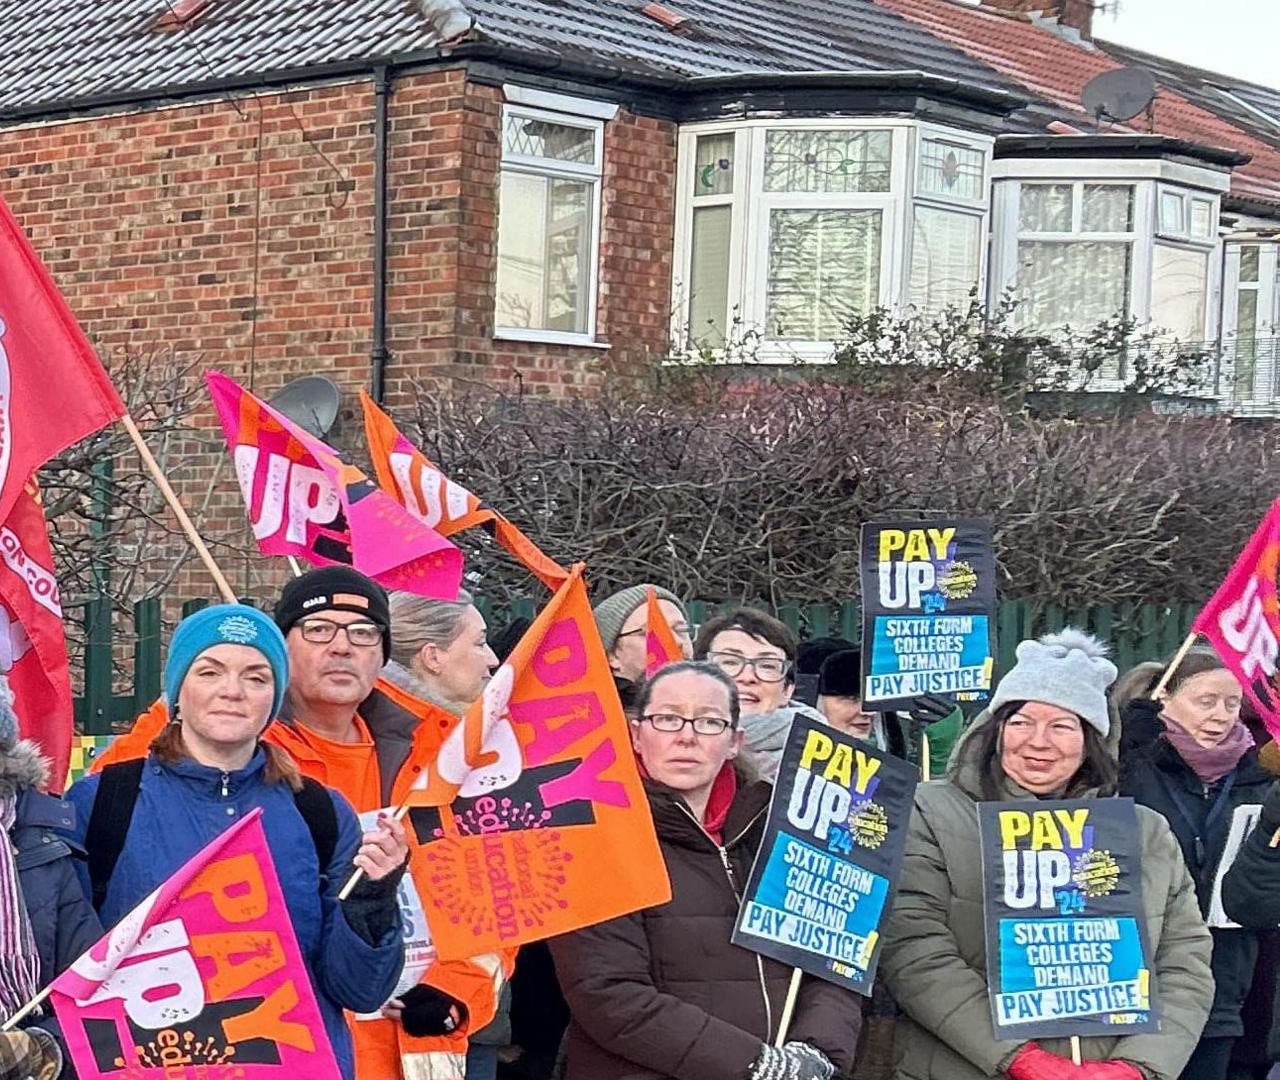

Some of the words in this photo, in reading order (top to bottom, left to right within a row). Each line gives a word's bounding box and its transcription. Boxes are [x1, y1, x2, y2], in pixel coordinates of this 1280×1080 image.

[234, 445, 342, 545] UP
[879, 528, 956, 561] PAY
[878, 561, 935, 609] UP
[886, 619, 930, 636] SIXTH
[934, 617, 972, 634] FORM
[894, 636, 964, 653] COLLEGES
[871, 676, 905, 696] PAY
[909, 657, 993, 694] JUSTICE!
[899, 653, 960, 671] DEMAND
[508, 617, 631, 808] PAY
[799, 729, 881, 794] PAY
[787, 767, 851, 840] UP
[999, 808, 1089, 850] PAY
[475, 796, 519, 941] education
[784, 843, 830, 875] SIXTH
[832, 858, 873, 894] FORM
[785, 866, 859, 913] COLLEGES
[1002, 850, 1071, 909] UP
[784, 889, 847, 930] DEMAND
[1014, 923, 1069, 944] SIXTH
[1074, 920, 1121, 941] FORM
[182, 852, 316, 1053] PAY
[747, 905, 787, 937] PAY
[790, 919, 879, 966] JUSTICE!
[1027, 943, 1112, 965] COLLEGES
[1002, 992, 1044, 1019] PAY
[1051, 969, 1149, 1015] JUSTICE!
[1034, 964, 1109, 987] DEMAND
